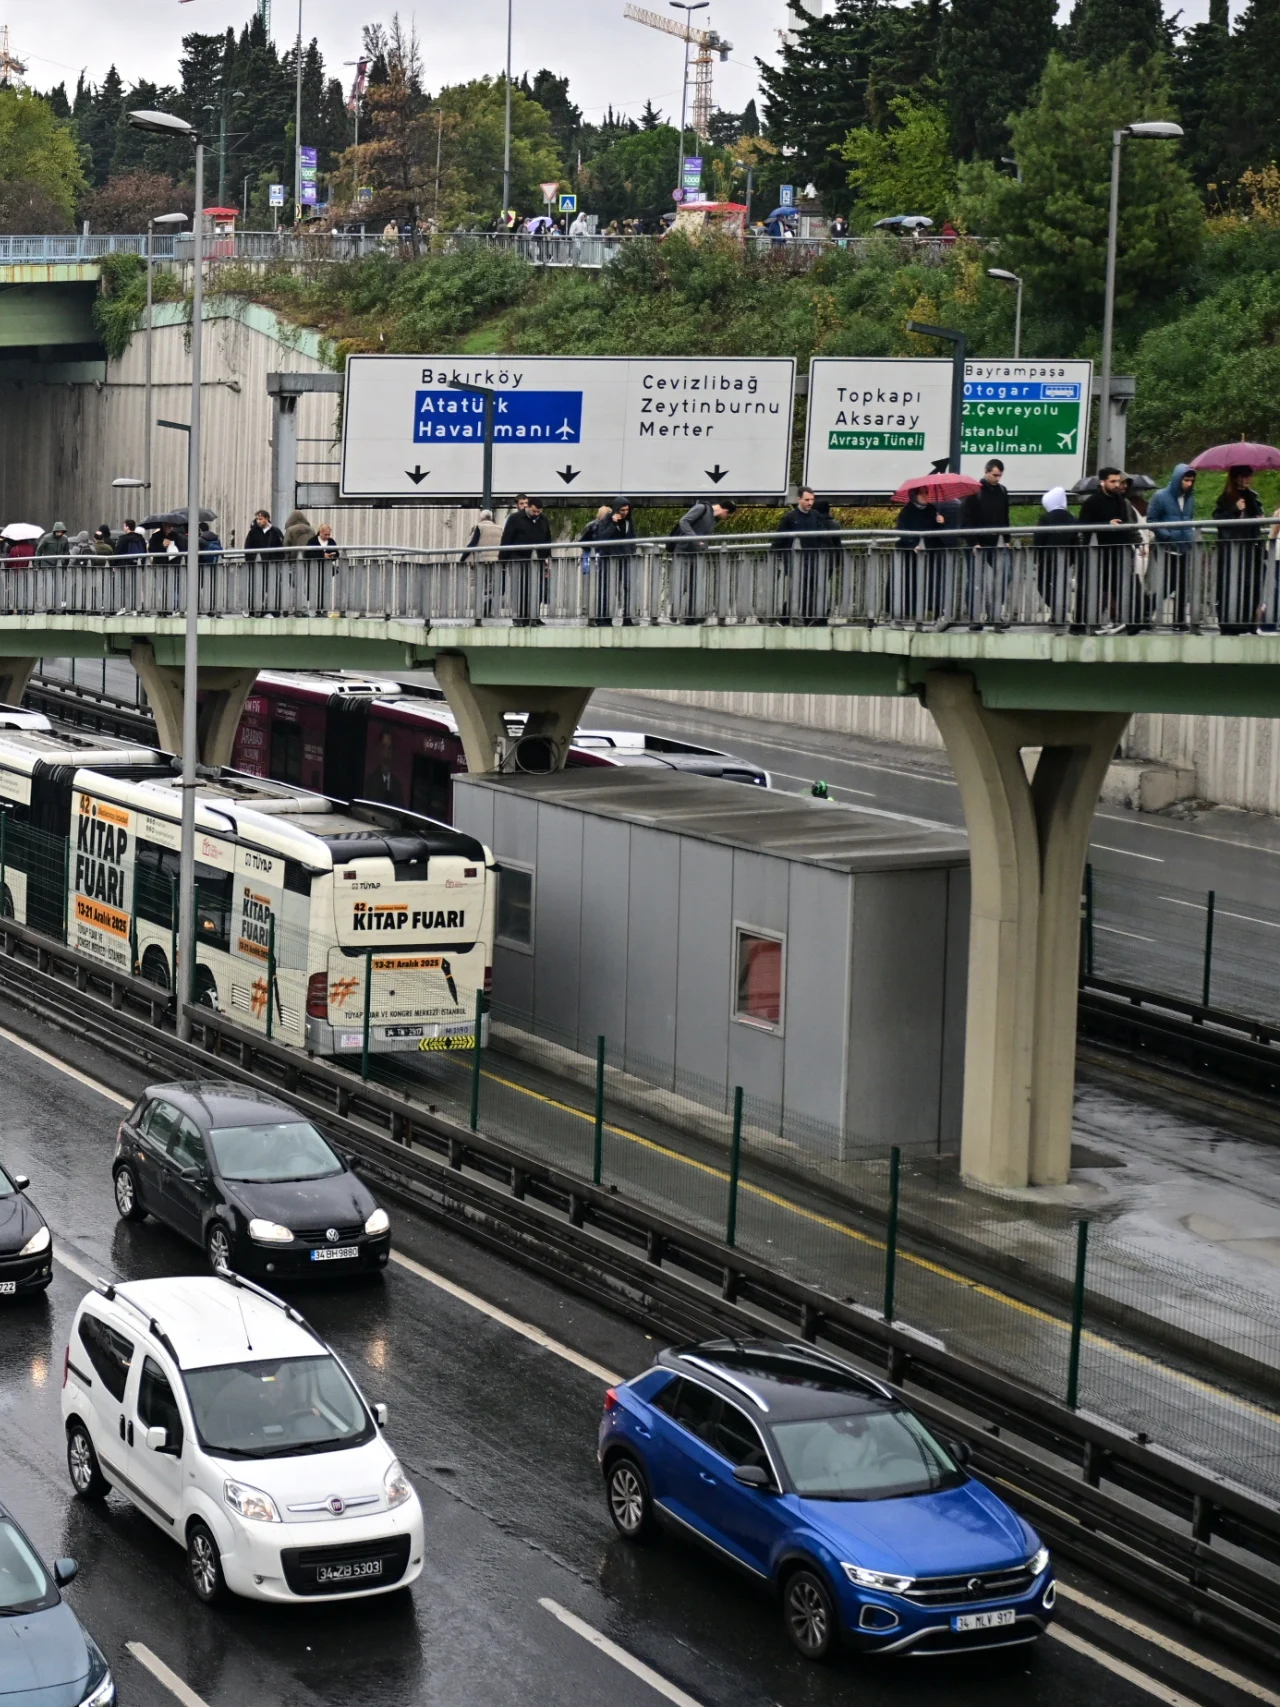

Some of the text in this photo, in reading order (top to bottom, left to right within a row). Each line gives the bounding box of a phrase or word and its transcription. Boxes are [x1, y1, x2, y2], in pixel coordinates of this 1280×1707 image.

[421, 369, 523, 388] Bakırköy
[965, 365, 1065, 379] Bayrampaşa
[643, 374, 758, 394] Cevizlibağ
[963, 384, 1029, 399] Otogar
[421, 397, 509, 413] Atatük
[836, 388, 921, 406] Topkapı
[641, 398, 779, 417] Zeytinburnu
[962, 403, 1059, 418] 2.Çevreyolu
[419, 421, 550, 437] Havalmanı
[639, 421, 714, 437] Merter
[835, 411, 920, 429] Aksaray
[830, 432, 923, 449] Avrasya Tüneli
[80, 795, 90, 814] 42
[77, 804, 128, 865] KİTAP
[252, 854, 272, 872] TÜYAP
[75, 854, 125, 909] FUARI
[242, 894, 270, 924] KİTAP
[354, 902, 366, 911] 42
[77, 901, 127, 933] 13-21 Aralık 2025
[353, 906, 465, 930] KİTAP FUARI
[241, 920, 269, 946] FUARI
[374, 959, 439, 968] 13-21 Aralık 2025
[345, 1011, 362, 1019] TÜYAP
[414, 1008, 438, 1017] MERKEZİ
[441, 1007, 466, 1016] İSTANBUL
[315, 1250, 325, 1259] 34
[0, 1282, 14, 1292] 722
[320, 1561, 379, 1579] 34 ZB 5303
[957, 1611, 1013, 1629] 34 MLV 917
